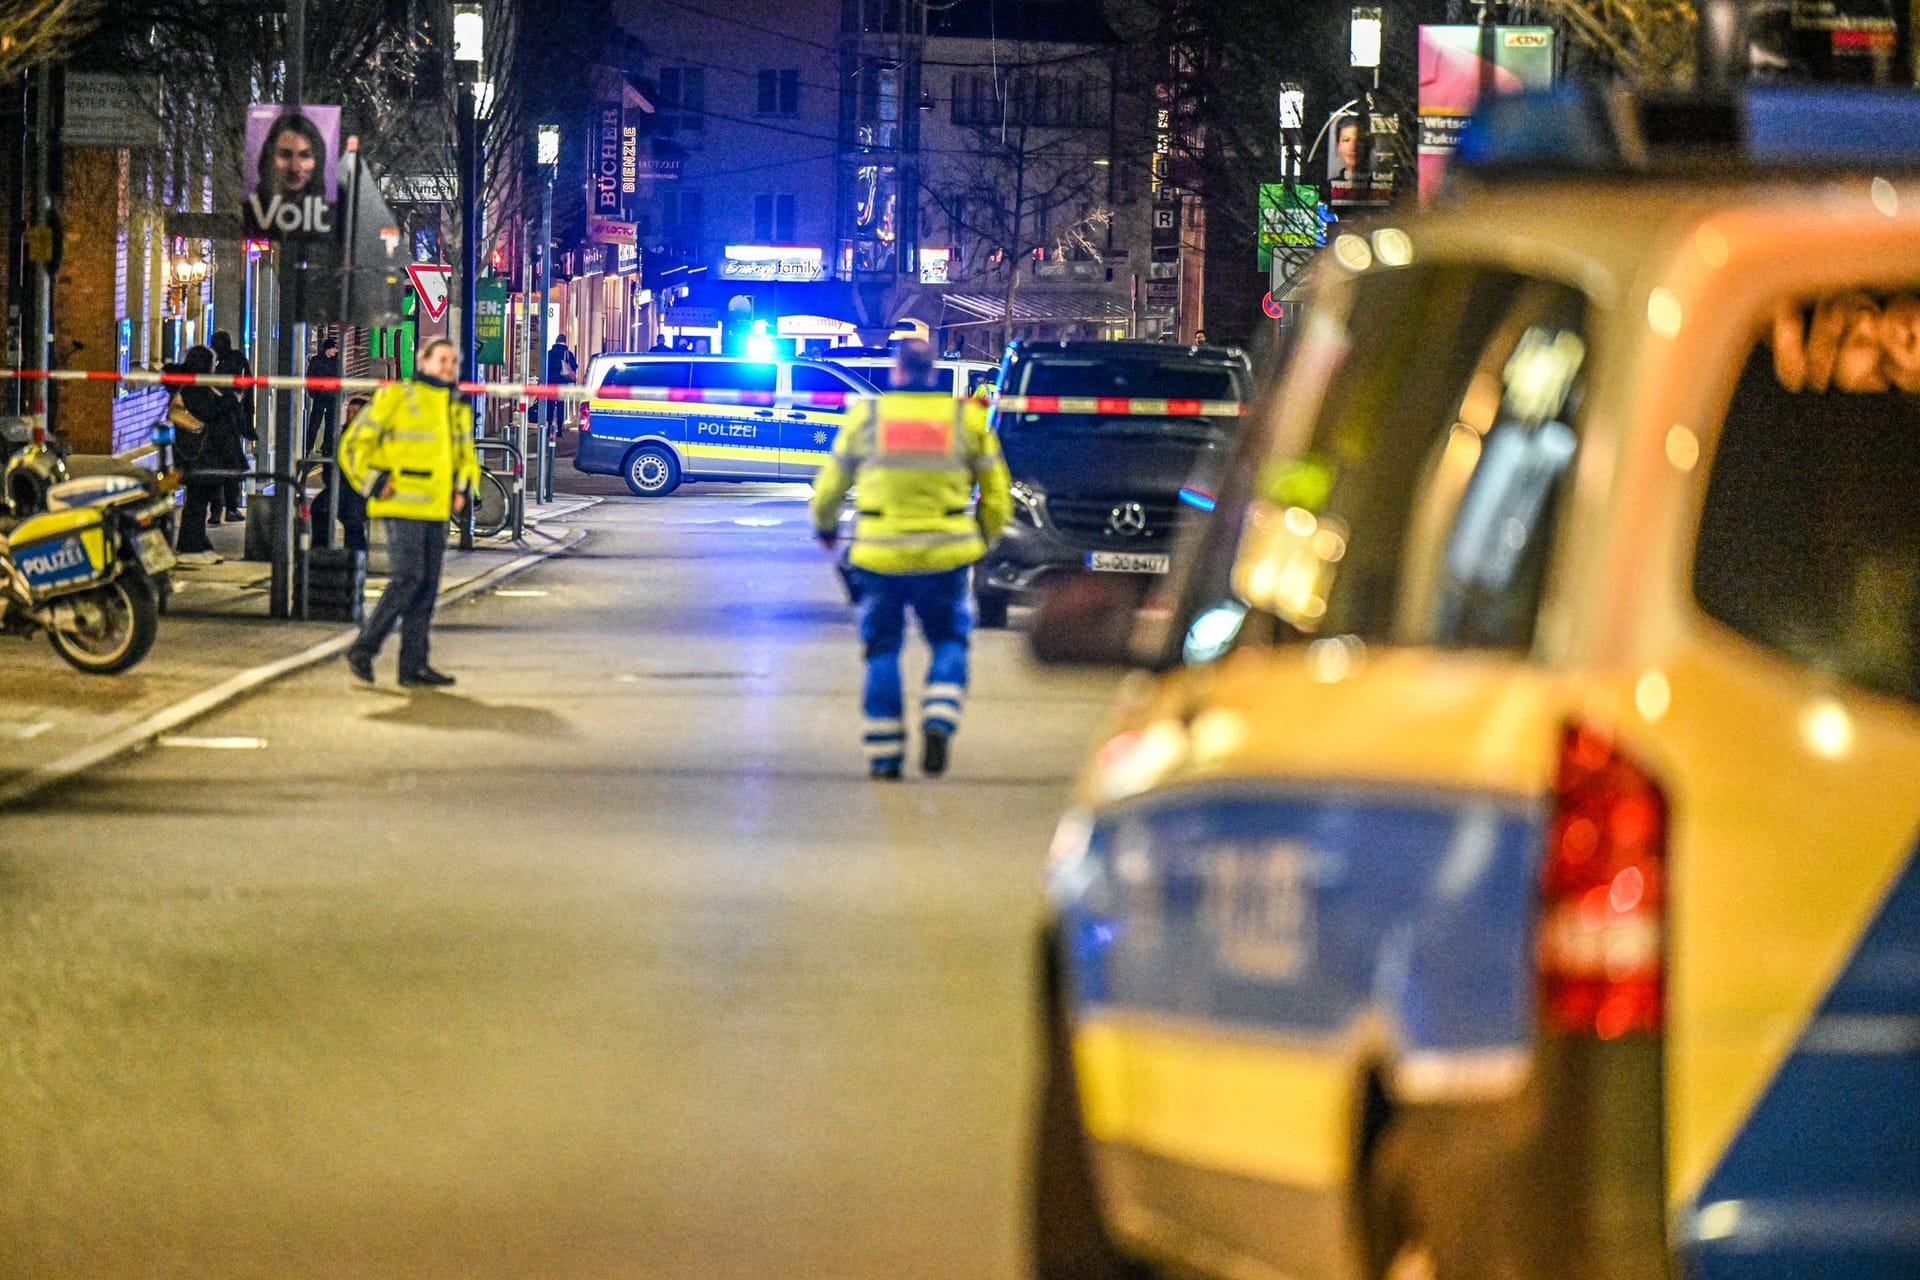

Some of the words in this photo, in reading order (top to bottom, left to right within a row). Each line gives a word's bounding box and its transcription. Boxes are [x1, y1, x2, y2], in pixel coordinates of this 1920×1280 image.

[1516, 35, 1545, 45] CDU
[1423, 116, 1471, 129] Wirtsc
[598, 108, 618, 208] BÜCHER
[622, 126, 637, 194] BIENZLE
[249, 193, 331, 233] Volt
[778, 260, 821, 277] family
[477, 301, 501, 315] EN:
[697, 421, 757, 438] POLIZEI
[22, 545, 85, 578] POLIZEI
